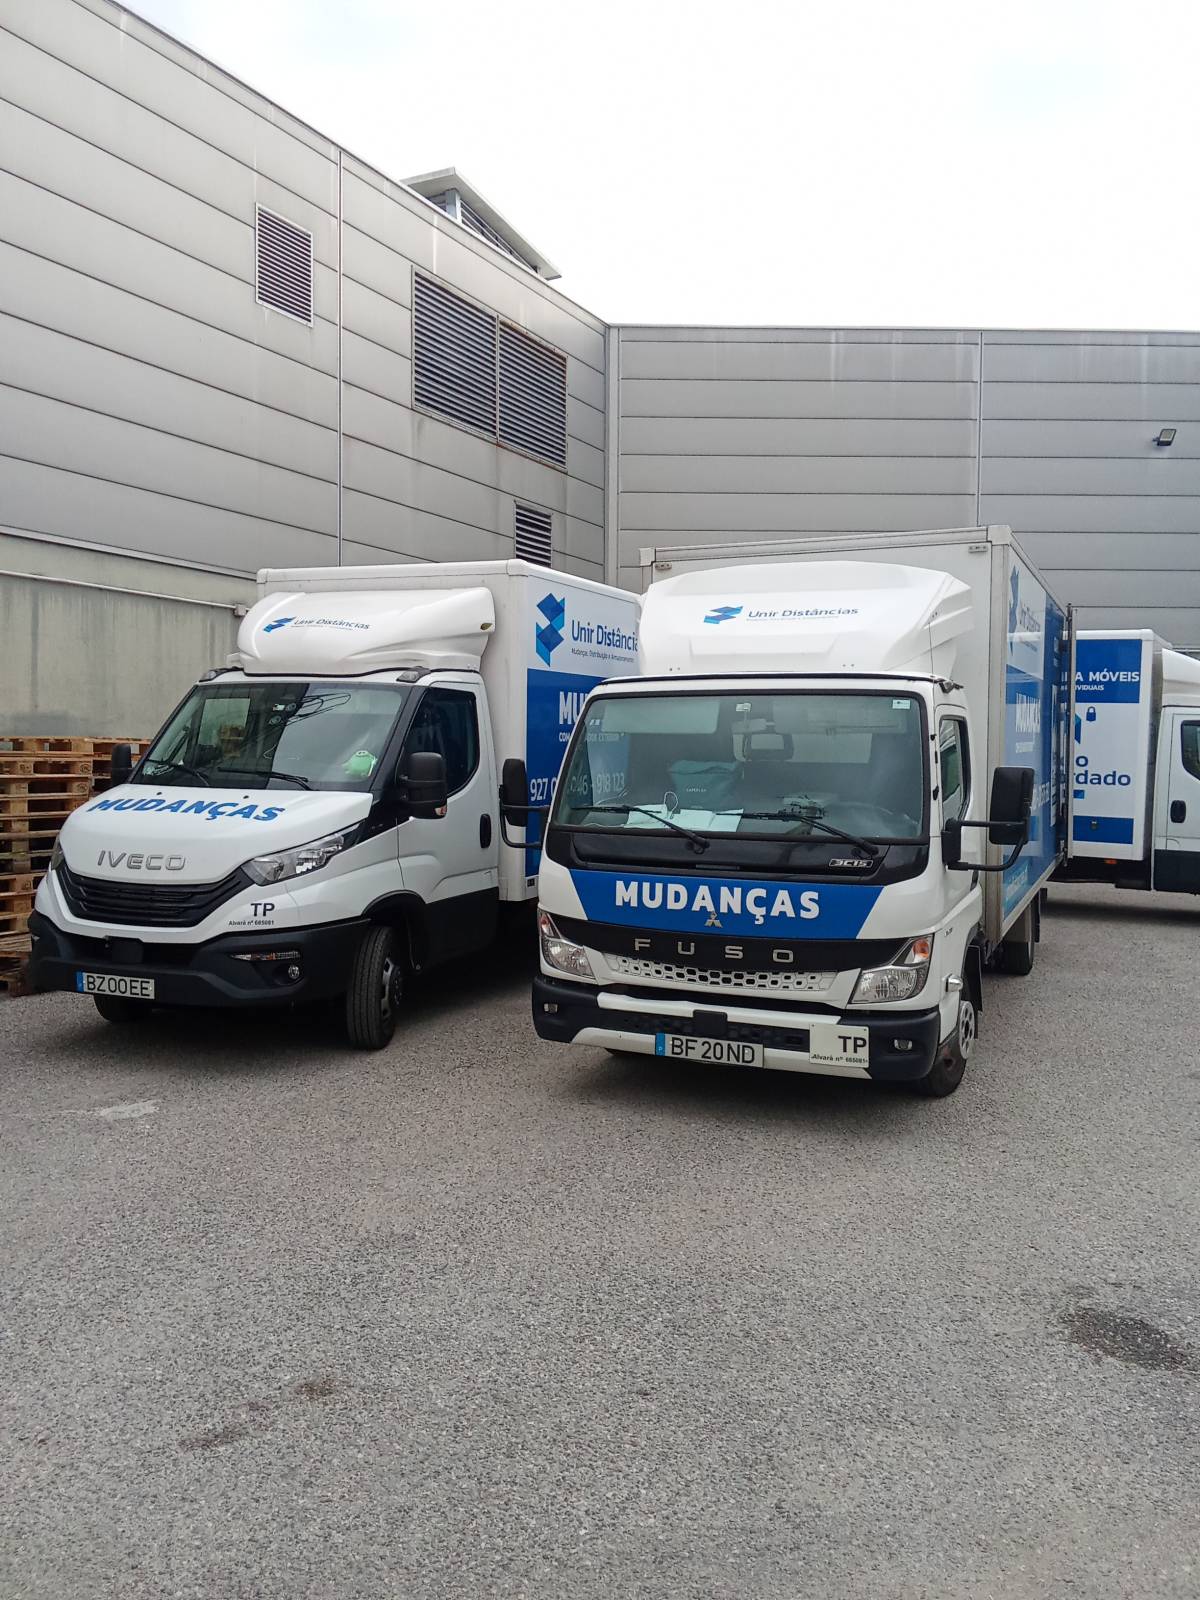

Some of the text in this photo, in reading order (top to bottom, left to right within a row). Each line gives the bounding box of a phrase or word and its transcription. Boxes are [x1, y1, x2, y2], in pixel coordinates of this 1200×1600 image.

[748, 606, 859, 618] Unir Distâncias
[571, 619, 595, 644] Unir
[1089, 667, 1140, 682] MÓVEIS
[1073, 769, 1131, 786] dado
[530, 777, 549, 802] 927
[86, 798, 286, 822] MUDANÇAS
[97, 850, 186, 871] IVECO
[250, 902, 276, 917] TP
[615, 880, 820, 925] MUDANÇAS
[634, 938, 794, 963] FUSO
[838, 1035, 867, 1054] TP
